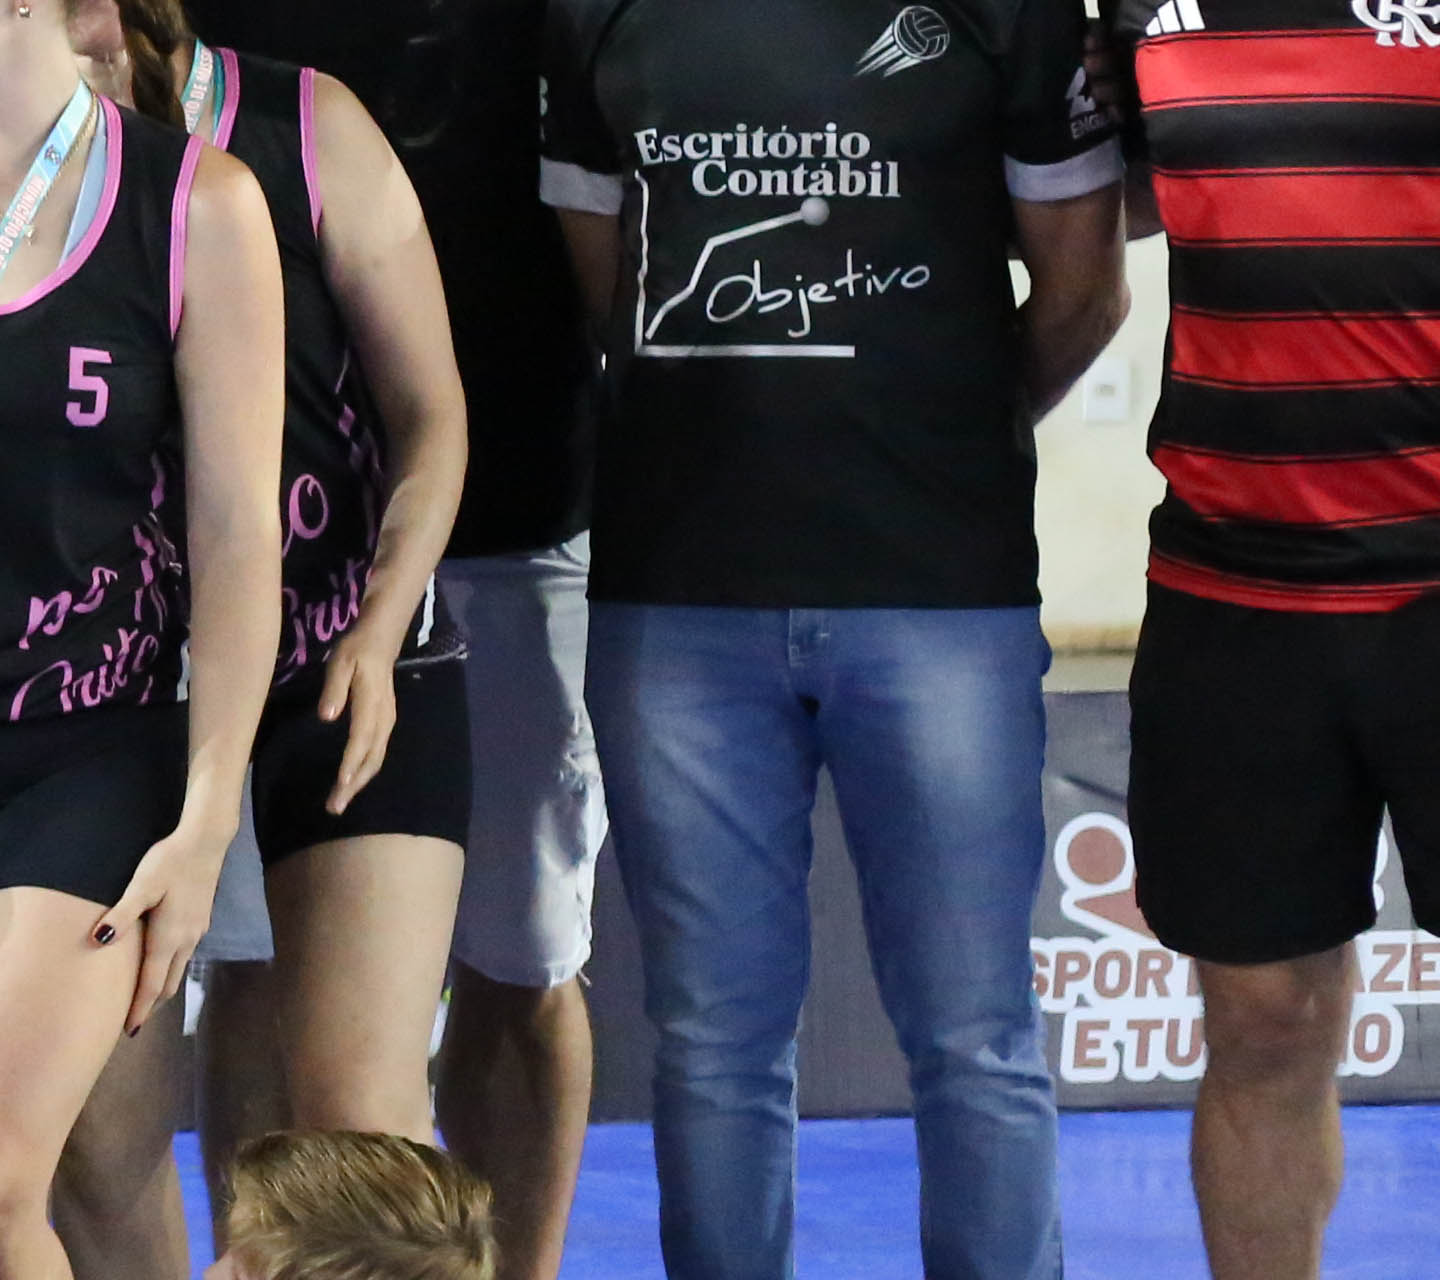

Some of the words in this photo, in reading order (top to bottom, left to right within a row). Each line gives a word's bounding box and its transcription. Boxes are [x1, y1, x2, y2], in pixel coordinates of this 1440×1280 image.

[634, 122, 871, 165] Escritório
[692, 160, 900, 198] Contábil
[706, 249, 930, 338] Objetivo
[65, 346, 113, 426] 5
